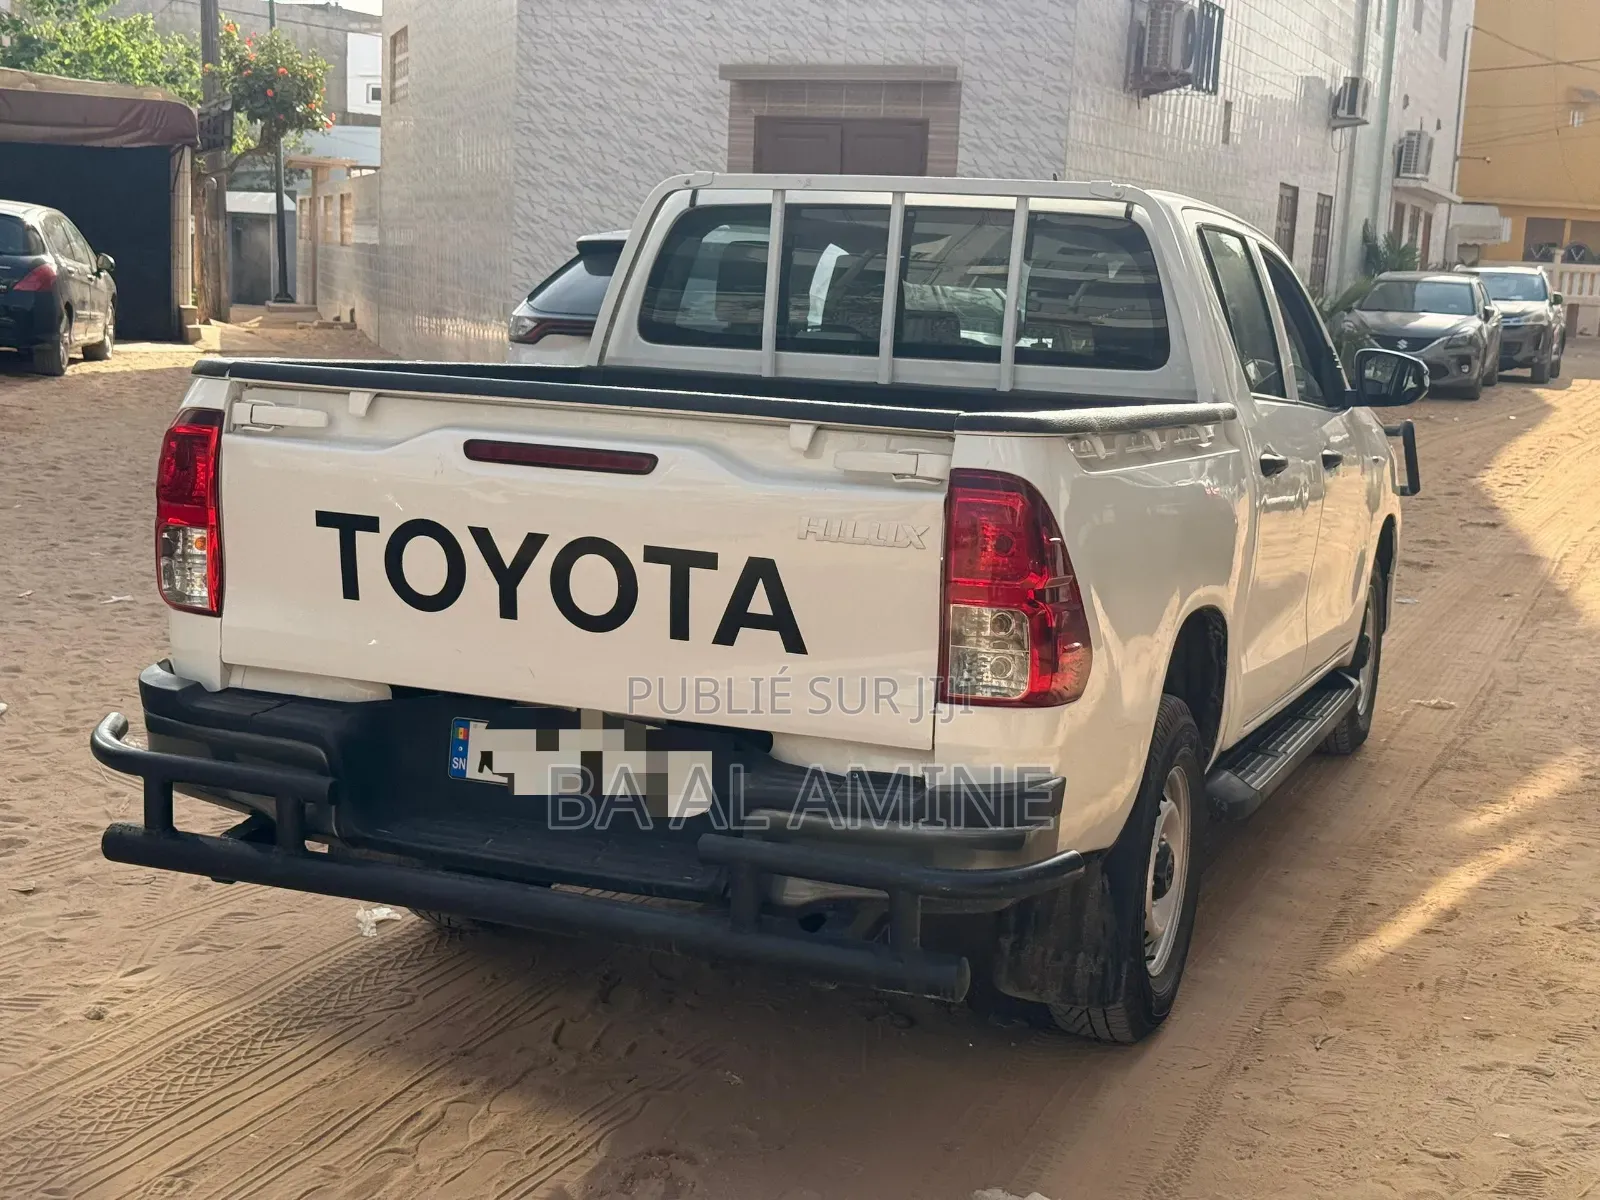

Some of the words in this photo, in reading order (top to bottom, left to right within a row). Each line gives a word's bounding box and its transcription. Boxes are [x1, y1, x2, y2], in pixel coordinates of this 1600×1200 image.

[797, 516, 930, 550] HILUX
[315, 510, 808, 655] TOYOTA
[452, 757, 467, 770] SN
